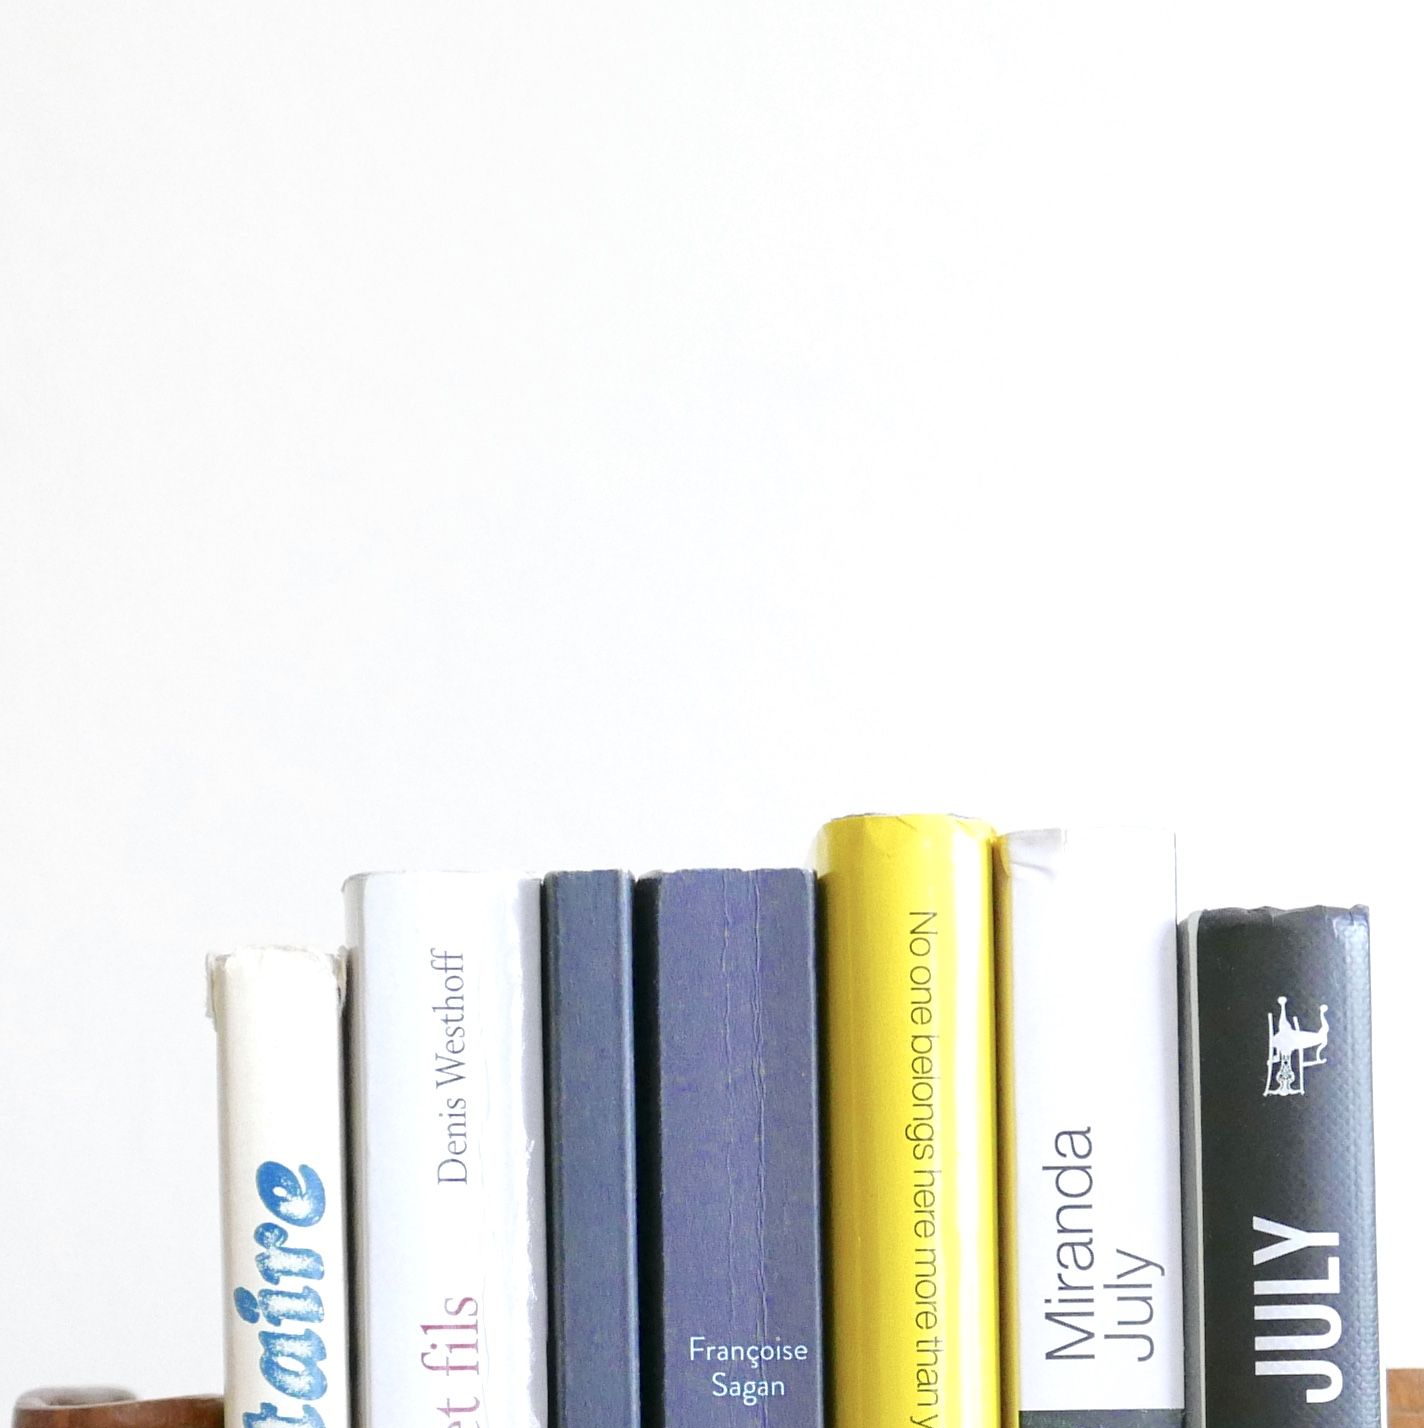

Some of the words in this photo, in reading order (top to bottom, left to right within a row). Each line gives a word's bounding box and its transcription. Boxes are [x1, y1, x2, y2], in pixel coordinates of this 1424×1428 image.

[909, 910, 938, 959] No
[430, 948, 466, 1090] Westhoff
[910, 963, 933, 1026] one
[905, 1033, 940, 1161] belongs
[437, 1096, 468, 1186] Denis
[913, 1168, 942, 1240] here
[1042, 1126, 1096, 1362] Miranda
[914, 1247, 938, 1332] more
[1103, 1247, 1165, 1363] July
[1251, 1215, 1344, 1404] JULY
[420, 1296, 479, 1376] fils
[688, 1335, 809, 1369] Françoise
[915, 1336, 946, 1406] than
[711, 1371, 786, 1406] Sagan
